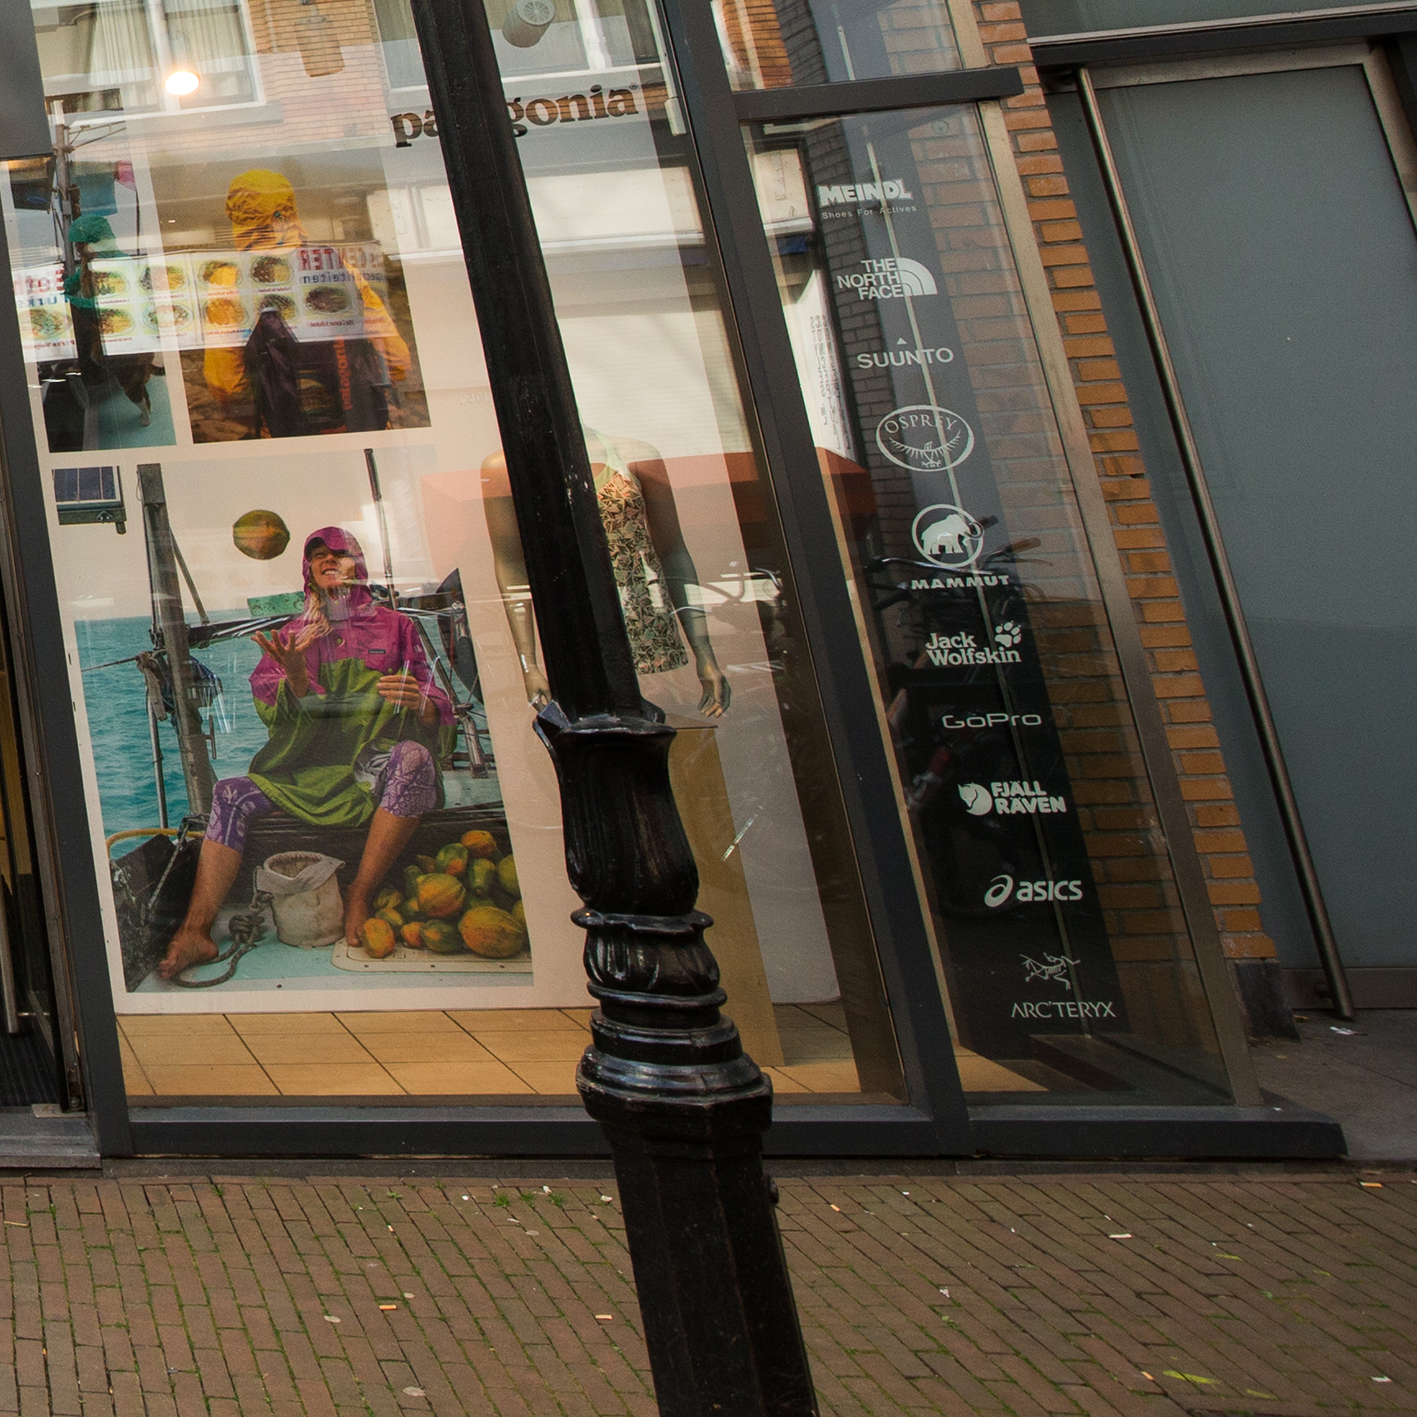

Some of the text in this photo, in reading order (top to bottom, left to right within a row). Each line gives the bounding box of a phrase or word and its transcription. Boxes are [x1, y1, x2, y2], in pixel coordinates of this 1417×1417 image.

[390, 84, 639, 148] pagonia
[817, 179, 913, 207] MEINDL
[821, 204, 917, 220] Shoes For Actives
[860, 258, 898, 273] THE
[837, 271, 901, 290] NORTH
[858, 284, 905, 301] FACE
[856, 347, 954, 369] SUUNTO
[883, 413, 959, 434] OSPREY
[911, 574, 1010, 590] MAMMUT
[925, 632, 977, 651] Jack
[927, 646, 1022, 666] Wolfskin
[942, 712, 1043, 730] GoPro
[991, 780, 1047, 799] FJÄLL
[995, 794, 1067, 815] RÄVEN
[1016, 879, 1083, 902] asics
